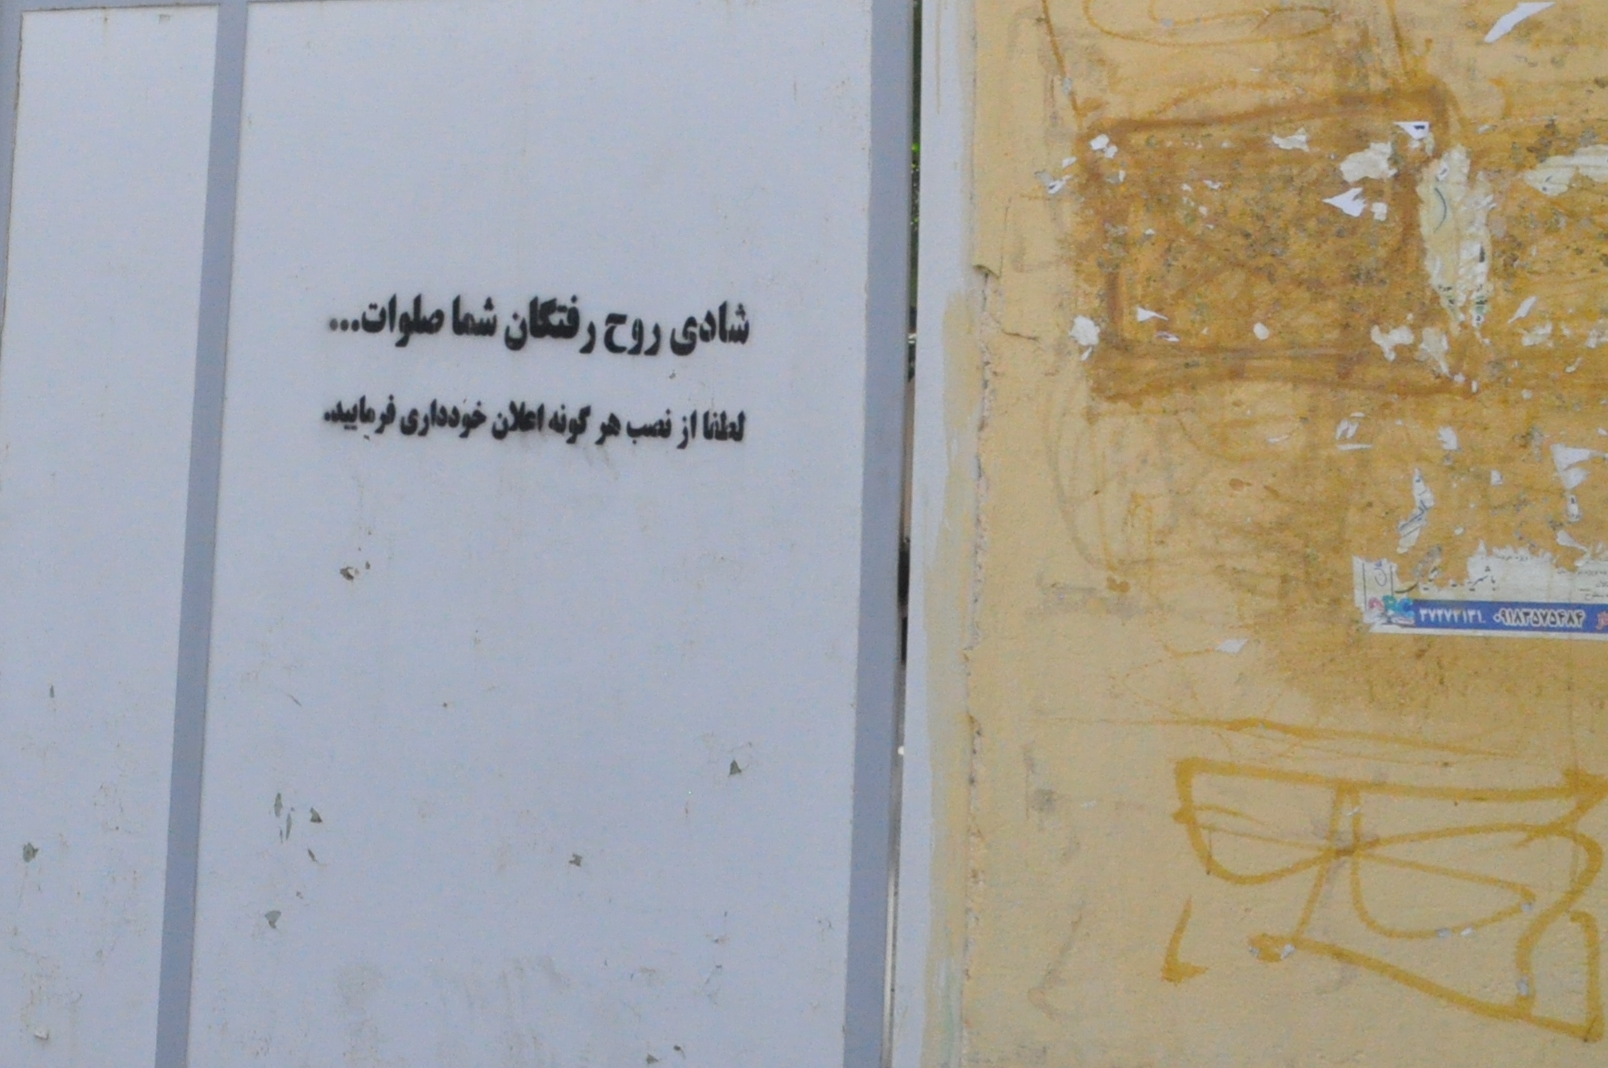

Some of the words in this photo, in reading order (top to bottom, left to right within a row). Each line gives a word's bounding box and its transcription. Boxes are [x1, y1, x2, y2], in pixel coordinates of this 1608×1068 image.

[452, 295, 497, 337] شما
[503, 295, 596, 353] رفتگان
[603, 312, 661, 356] روح
[669, 300, 750, 356] شادی
[399, 399, 487, 438] خودداری
[492, 400, 545, 439] اعلان
[548, 403, 592, 444] گونه
[595, 412, 622, 445] هر
[625, 408, 672, 445] نصب
[676, 409, 697, 450] از
[703, 409, 746, 443] لطفا
